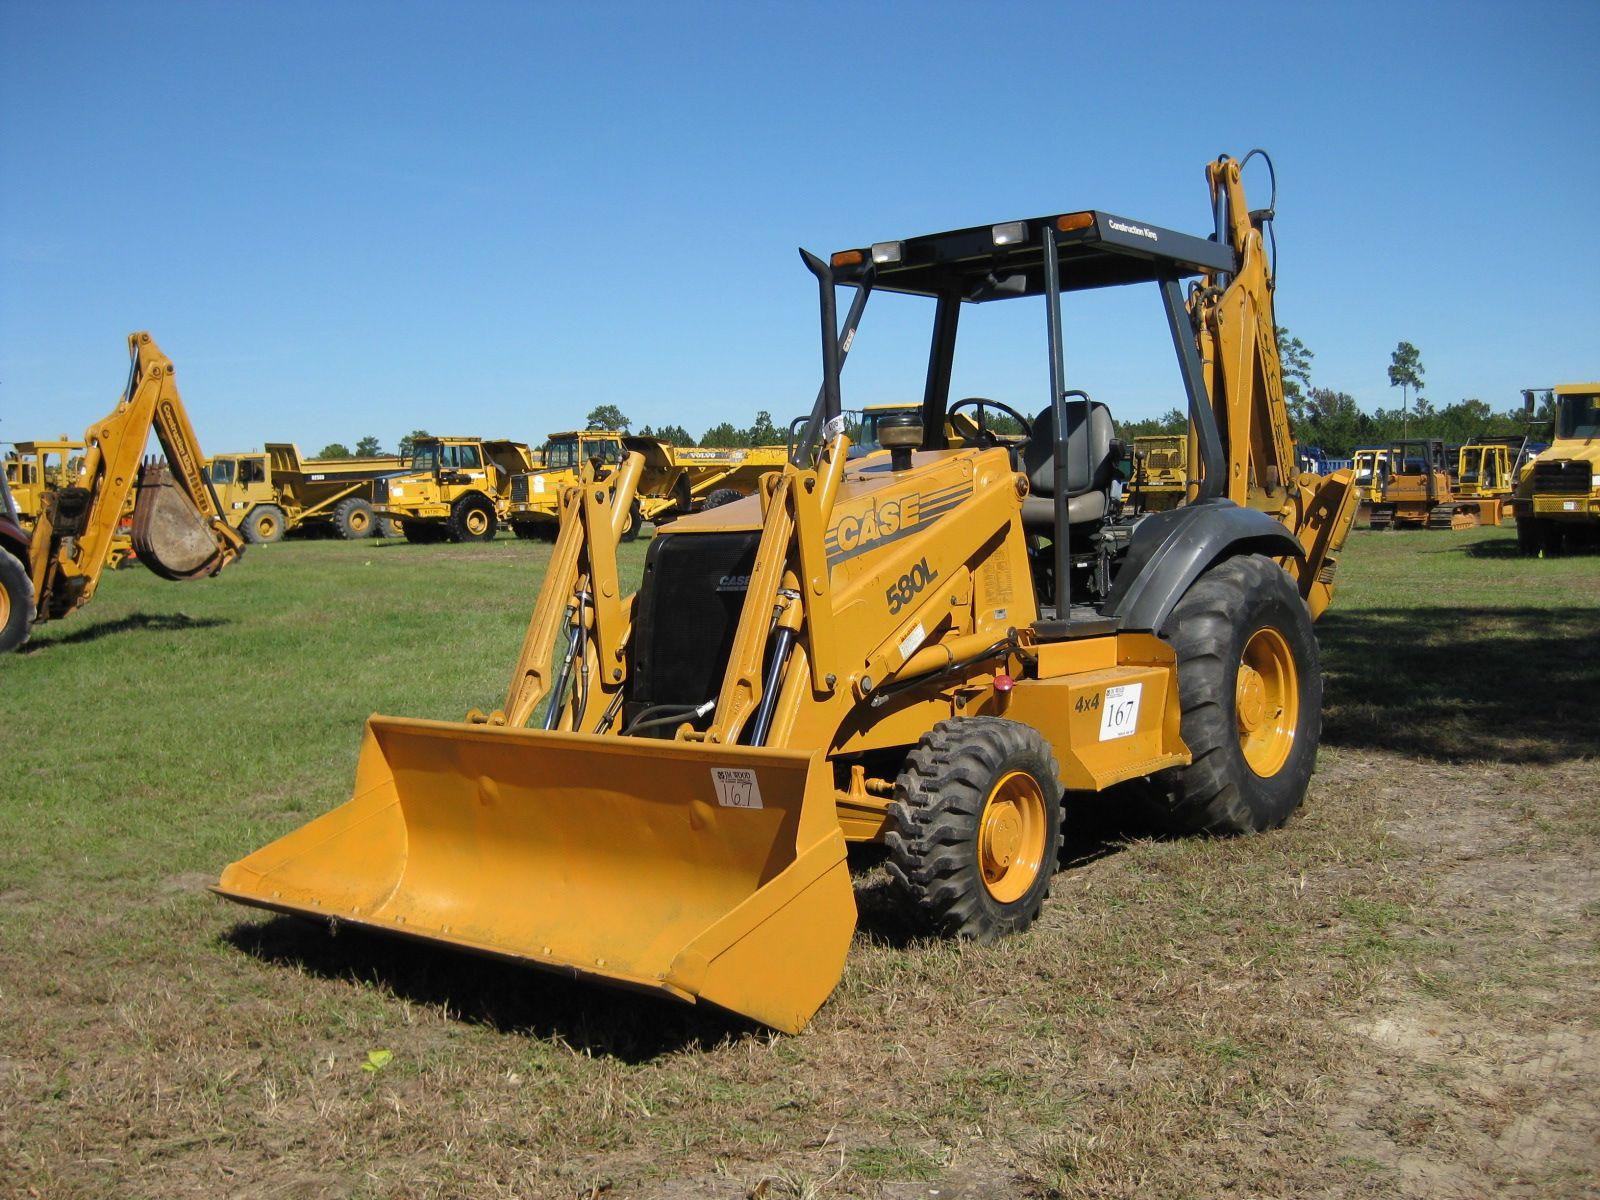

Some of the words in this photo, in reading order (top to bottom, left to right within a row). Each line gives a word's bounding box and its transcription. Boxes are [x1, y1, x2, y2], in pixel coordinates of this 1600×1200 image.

[1108, 219, 1145, 237] Construction
[1143, 227, 1158, 241] King
[162, 403, 187, 456] Construction
[182, 452, 196, 476] King
[837, 492, 920, 552] CASE
[886, 557, 939, 616] 580L
[1074, 692, 1100, 713] 4x4
[1106, 700, 1134, 728] 167
[723, 782, 753, 806] 167
